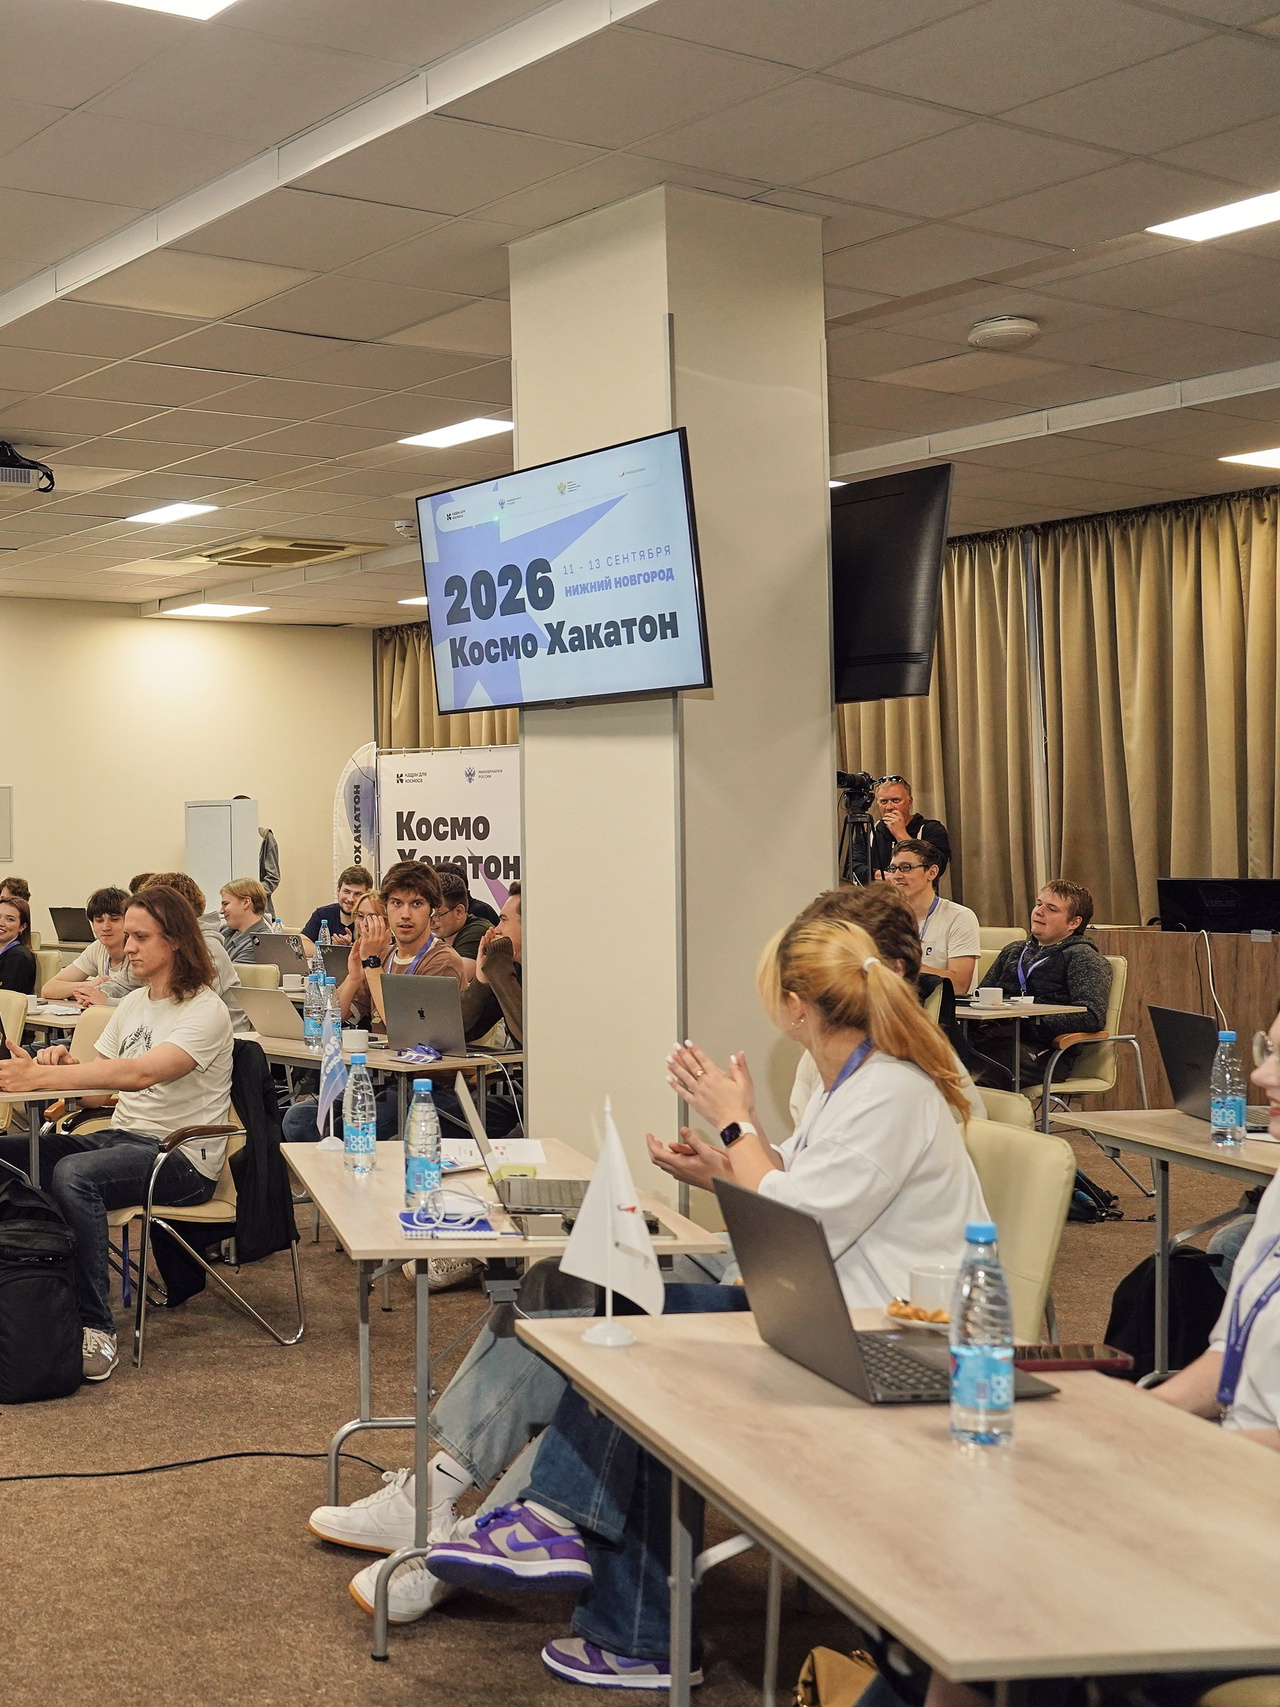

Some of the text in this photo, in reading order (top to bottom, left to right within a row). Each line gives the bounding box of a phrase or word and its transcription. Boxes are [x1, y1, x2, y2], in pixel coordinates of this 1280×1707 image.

[563, 565, 575, 575] 11
[589, 559, 601, 570] 13
[606, 545, 671, 567] СЕНТЯБРЯ
[564, 567, 674, 597] НИЖНИЙ НОВГОРОД
[444, 558, 555, 625] 2026
[450, 611, 679, 669] Космо Хакатон
[353, 785, 362, 867] ОХАКАТОН
[396, 811, 490, 841] Космо
